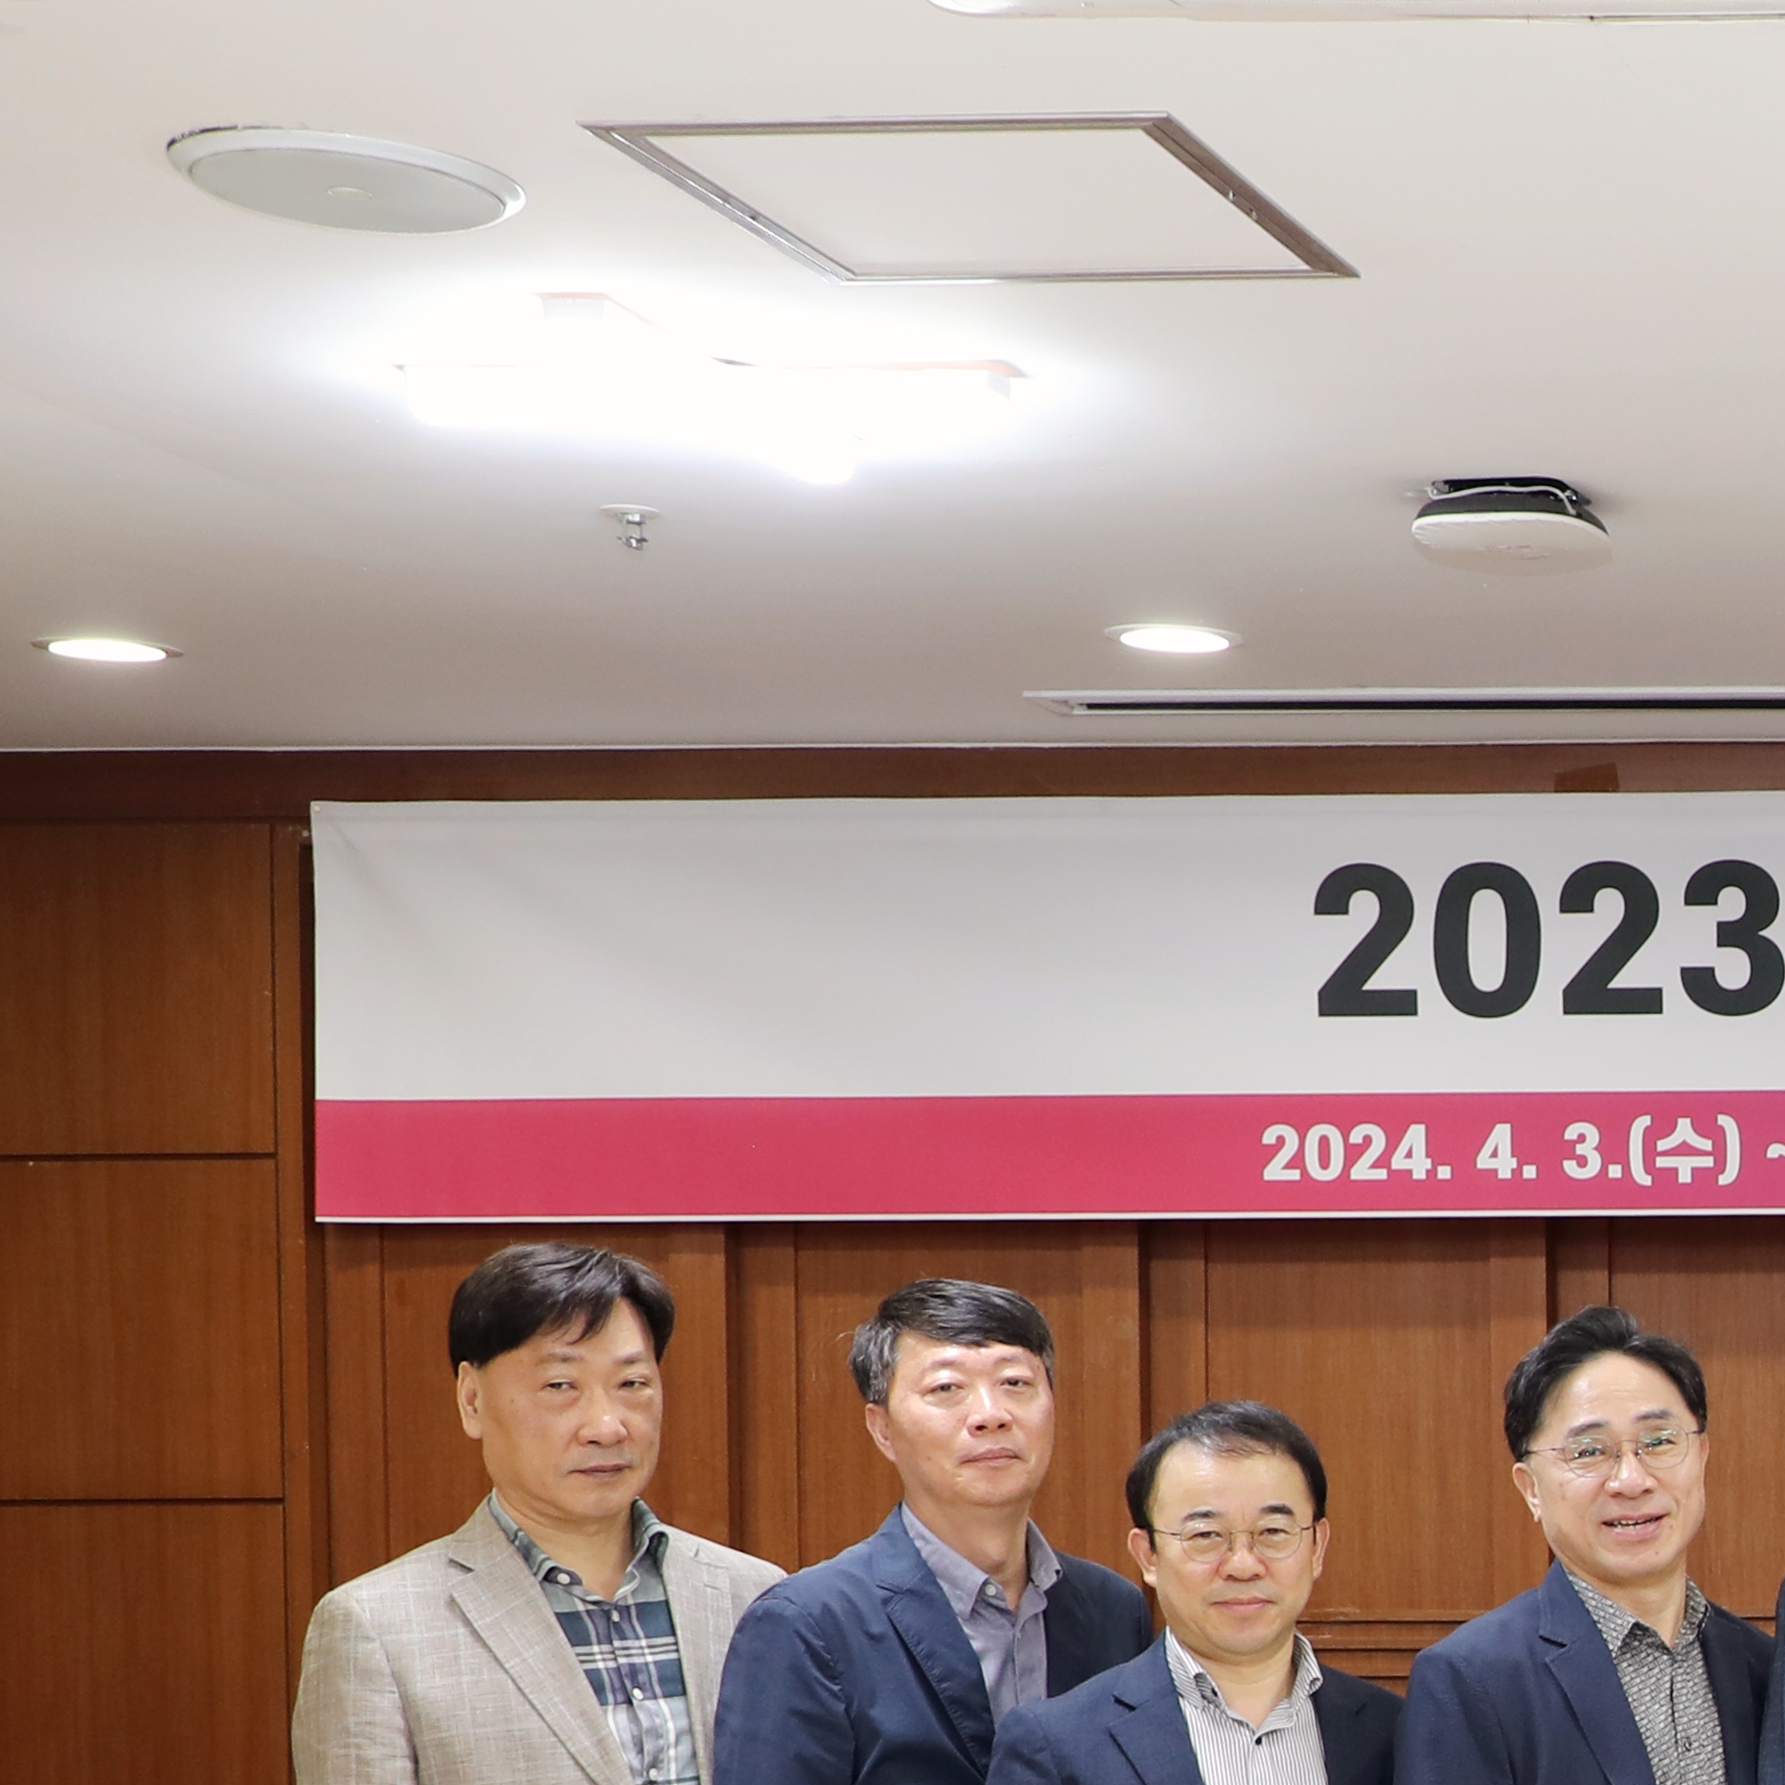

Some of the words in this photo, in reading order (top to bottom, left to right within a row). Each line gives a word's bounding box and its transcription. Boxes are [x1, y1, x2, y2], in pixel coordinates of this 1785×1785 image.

[1260, 1123, 1452, 1182] 2024.
[1475, 1122, 1538, 1180] 4.
[1561, 1114, 1742, 1187] 3.(수)
